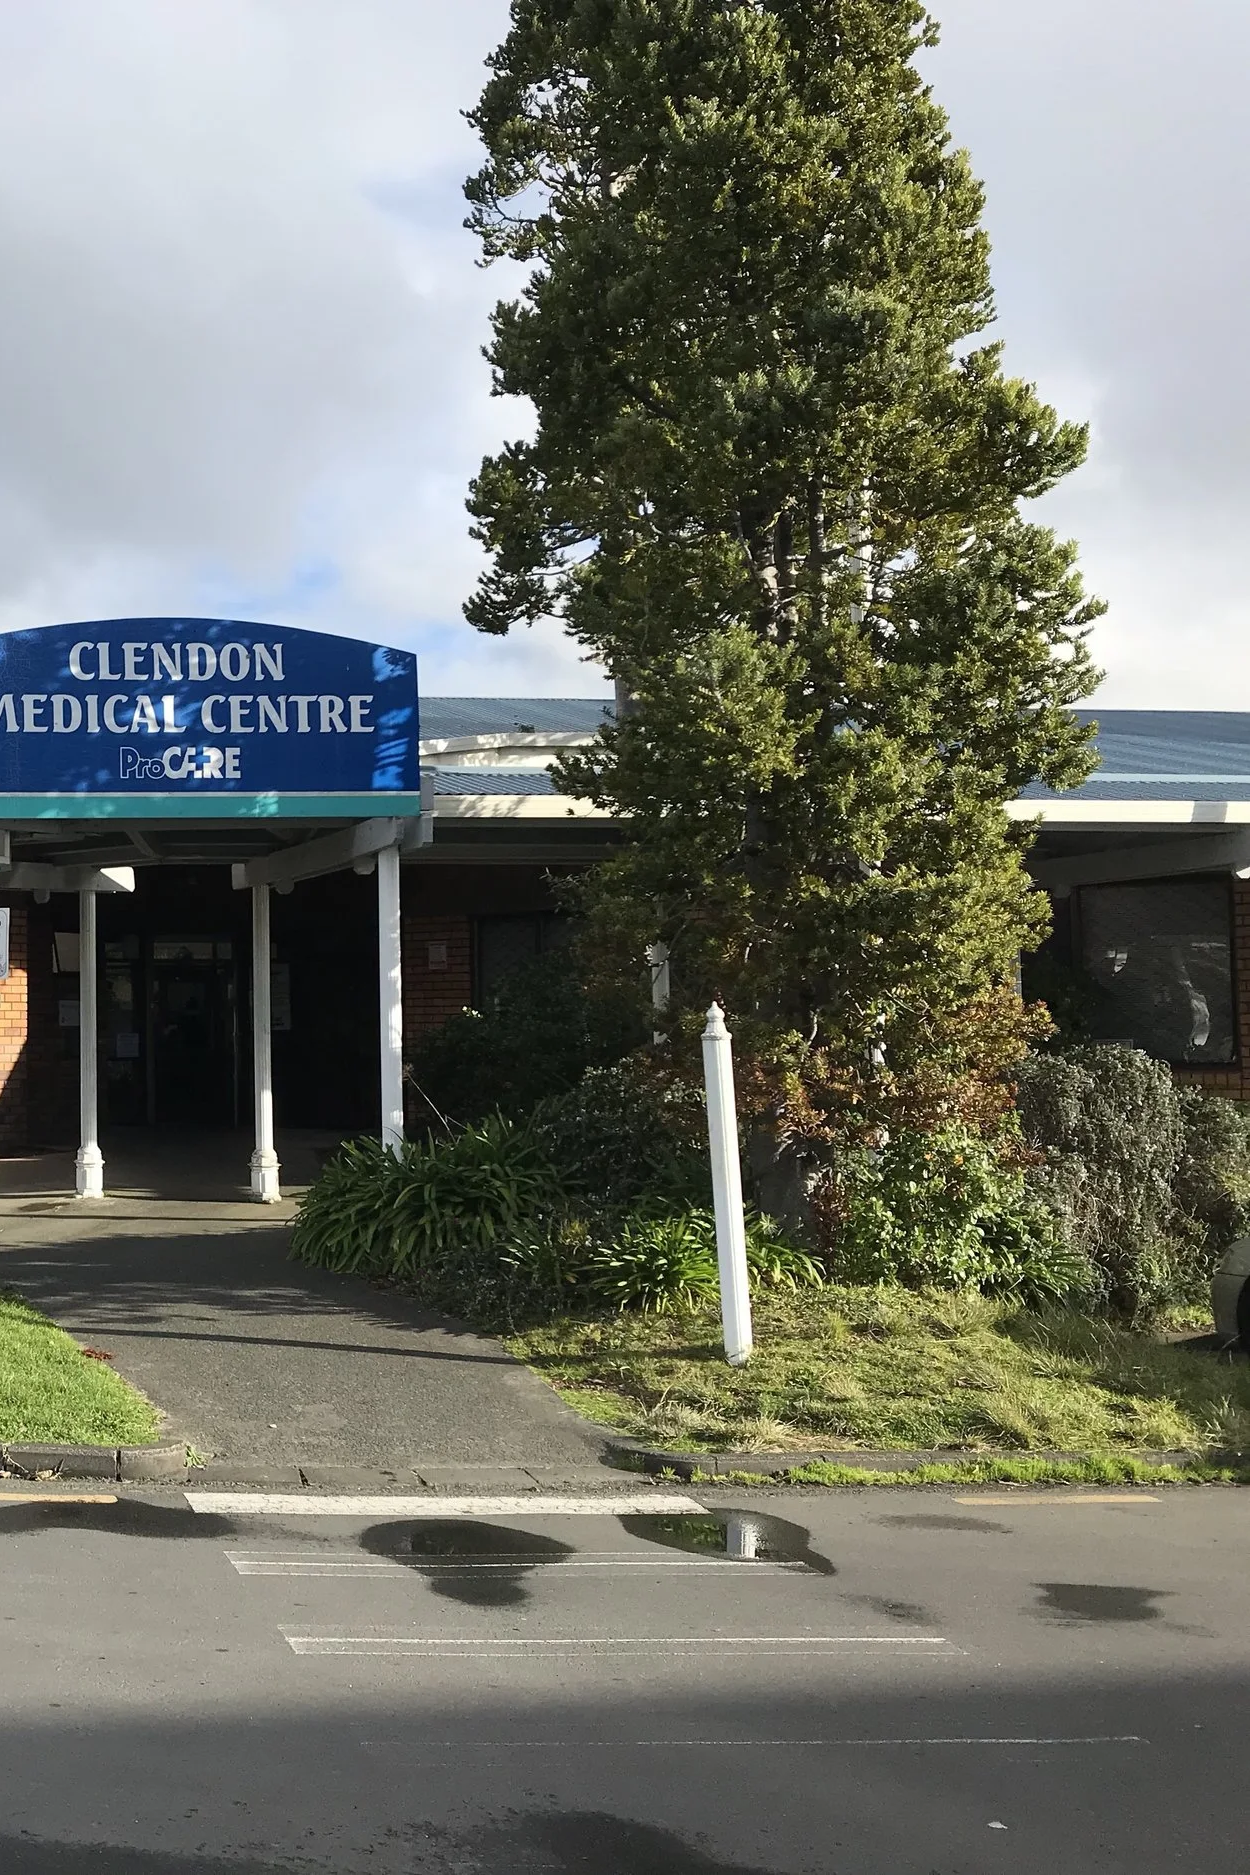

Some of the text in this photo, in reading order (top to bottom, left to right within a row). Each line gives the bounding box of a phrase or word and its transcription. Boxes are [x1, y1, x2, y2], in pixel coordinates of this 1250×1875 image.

[69, 641, 285, 682] CLENDON
[201, 695, 375, 734] CENTRE
[120, 746, 241, 779] ProCARE
